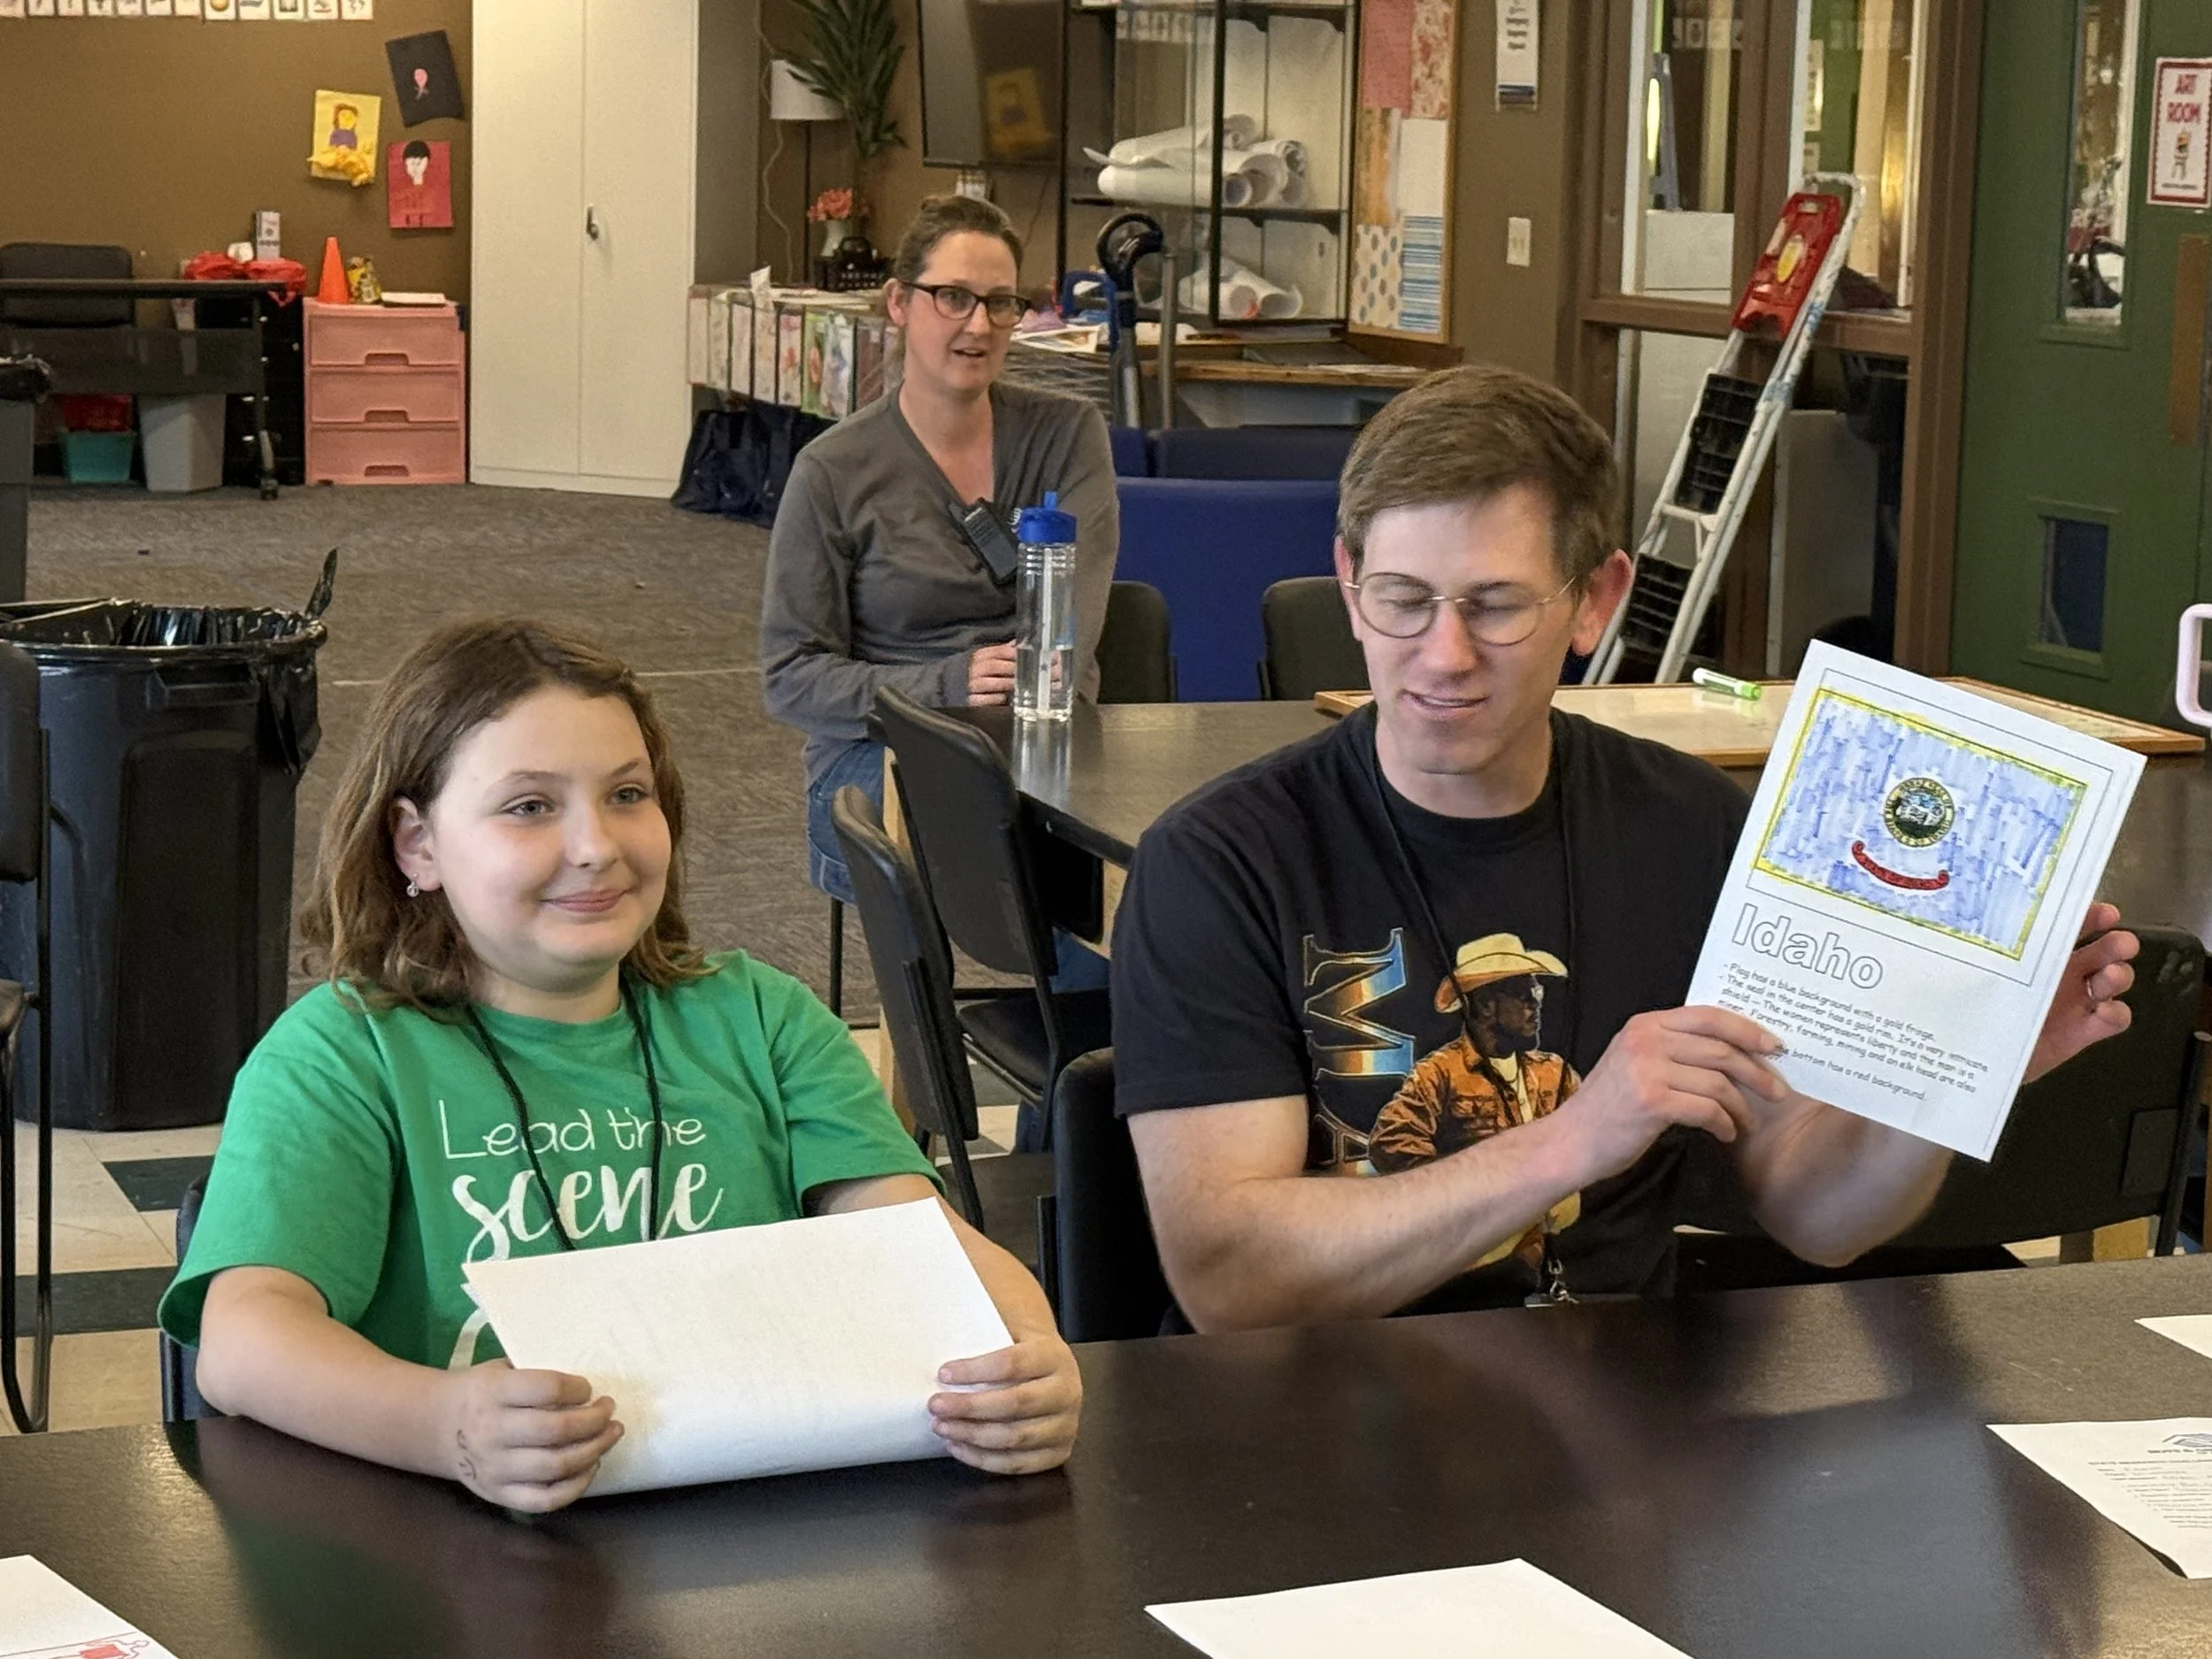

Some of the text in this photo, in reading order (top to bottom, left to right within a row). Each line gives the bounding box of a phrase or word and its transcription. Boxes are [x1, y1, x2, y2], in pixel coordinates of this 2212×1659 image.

[2166, 102, 2201, 124] ROOM
[2175, 74, 2198, 94] ART
[1731, 902, 1884, 990] Idaho
[439, 1100, 707, 1160] Lead the
[451, 1163, 724, 1263] scene
